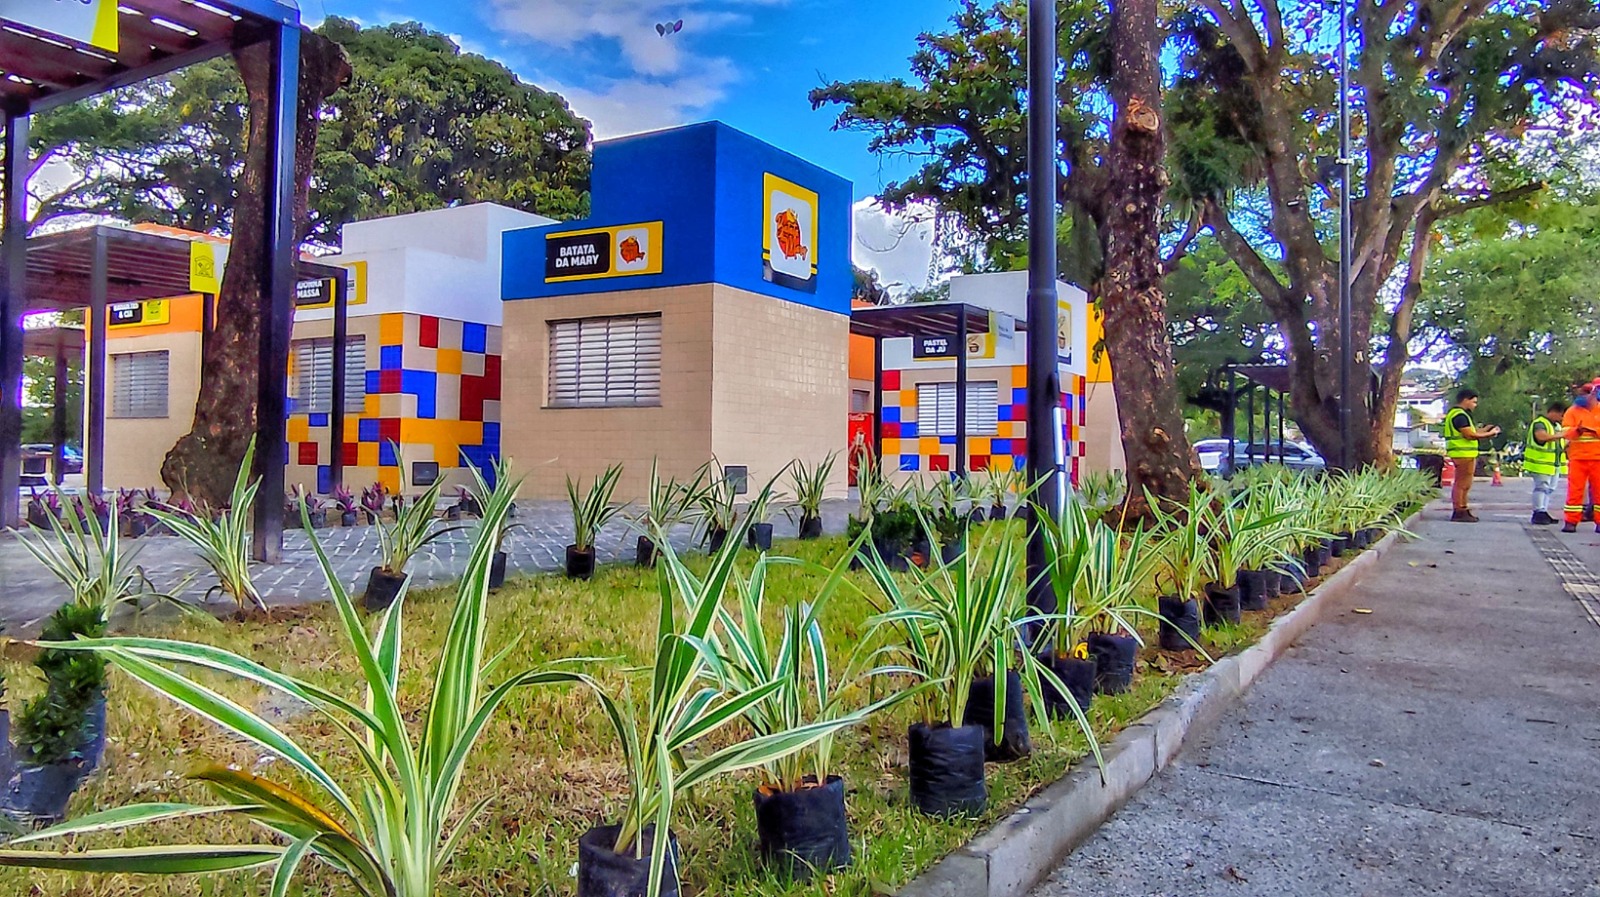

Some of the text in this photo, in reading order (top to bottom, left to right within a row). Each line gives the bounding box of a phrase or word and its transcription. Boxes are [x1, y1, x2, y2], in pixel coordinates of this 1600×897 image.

[560, 244, 595, 257] BATATA
[555, 254, 599, 268] DA MARY
[923, 339, 948, 347] PASTEL
